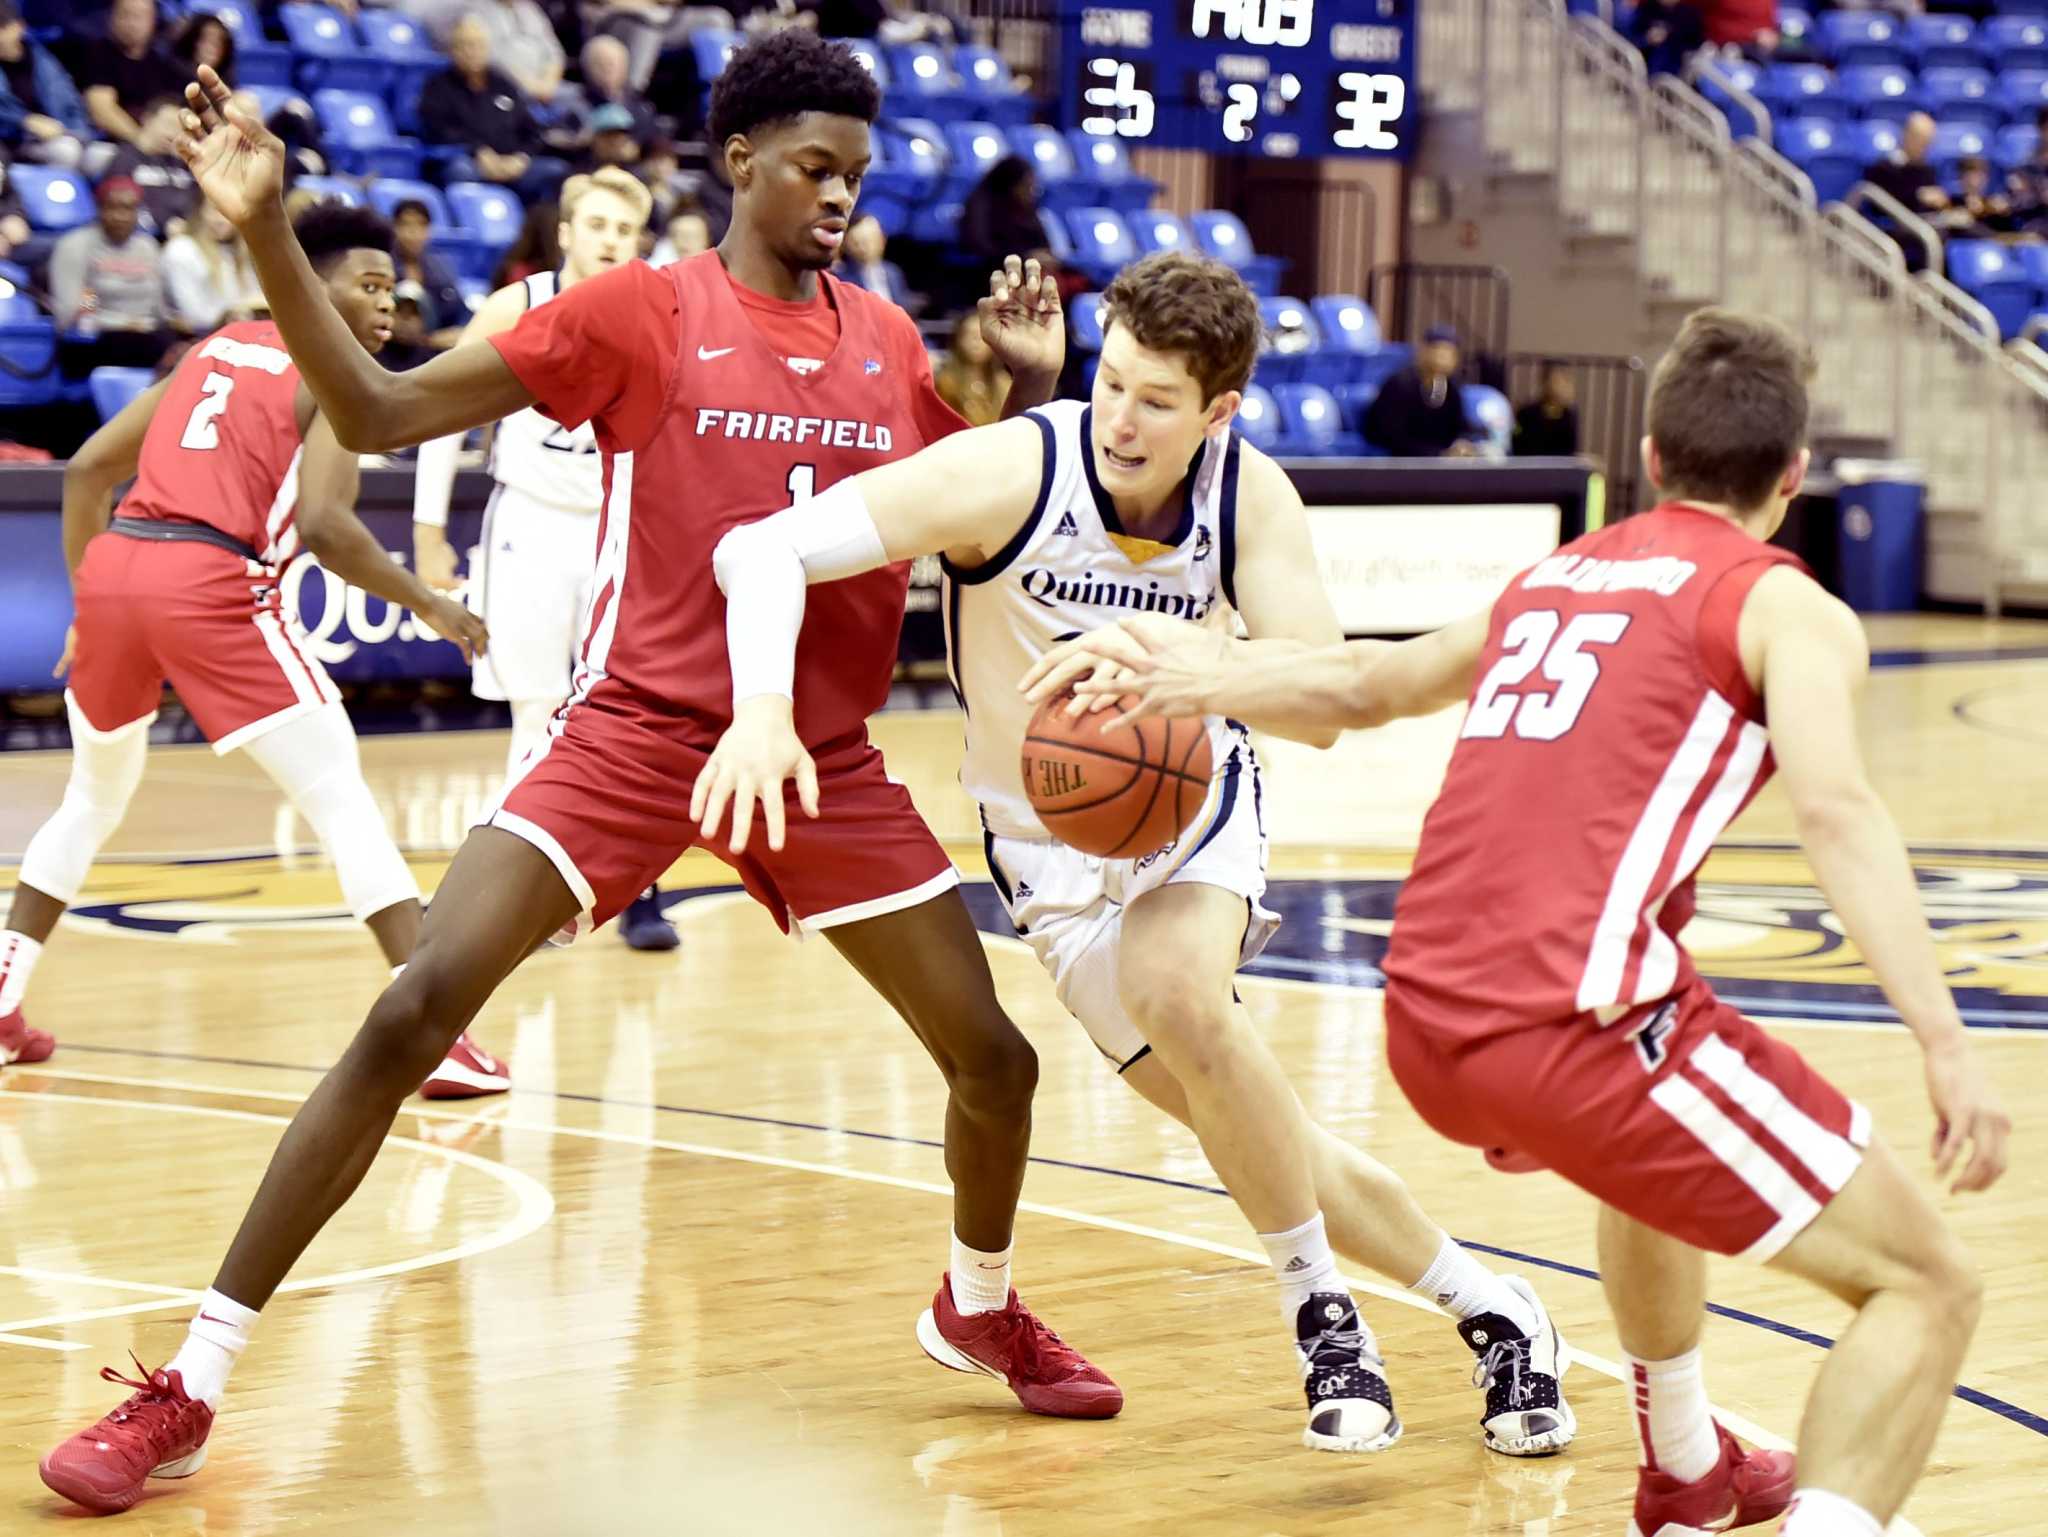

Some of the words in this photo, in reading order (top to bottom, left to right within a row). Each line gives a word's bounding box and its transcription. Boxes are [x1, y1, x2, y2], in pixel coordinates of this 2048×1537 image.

[180, 370, 235, 450] 2
[696, 408, 893, 451] FAIRFIELD
[786, 463, 815, 508] 1
[1459, 609, 1633, 742] 25
[1039, 759, 1087, 797] THE
